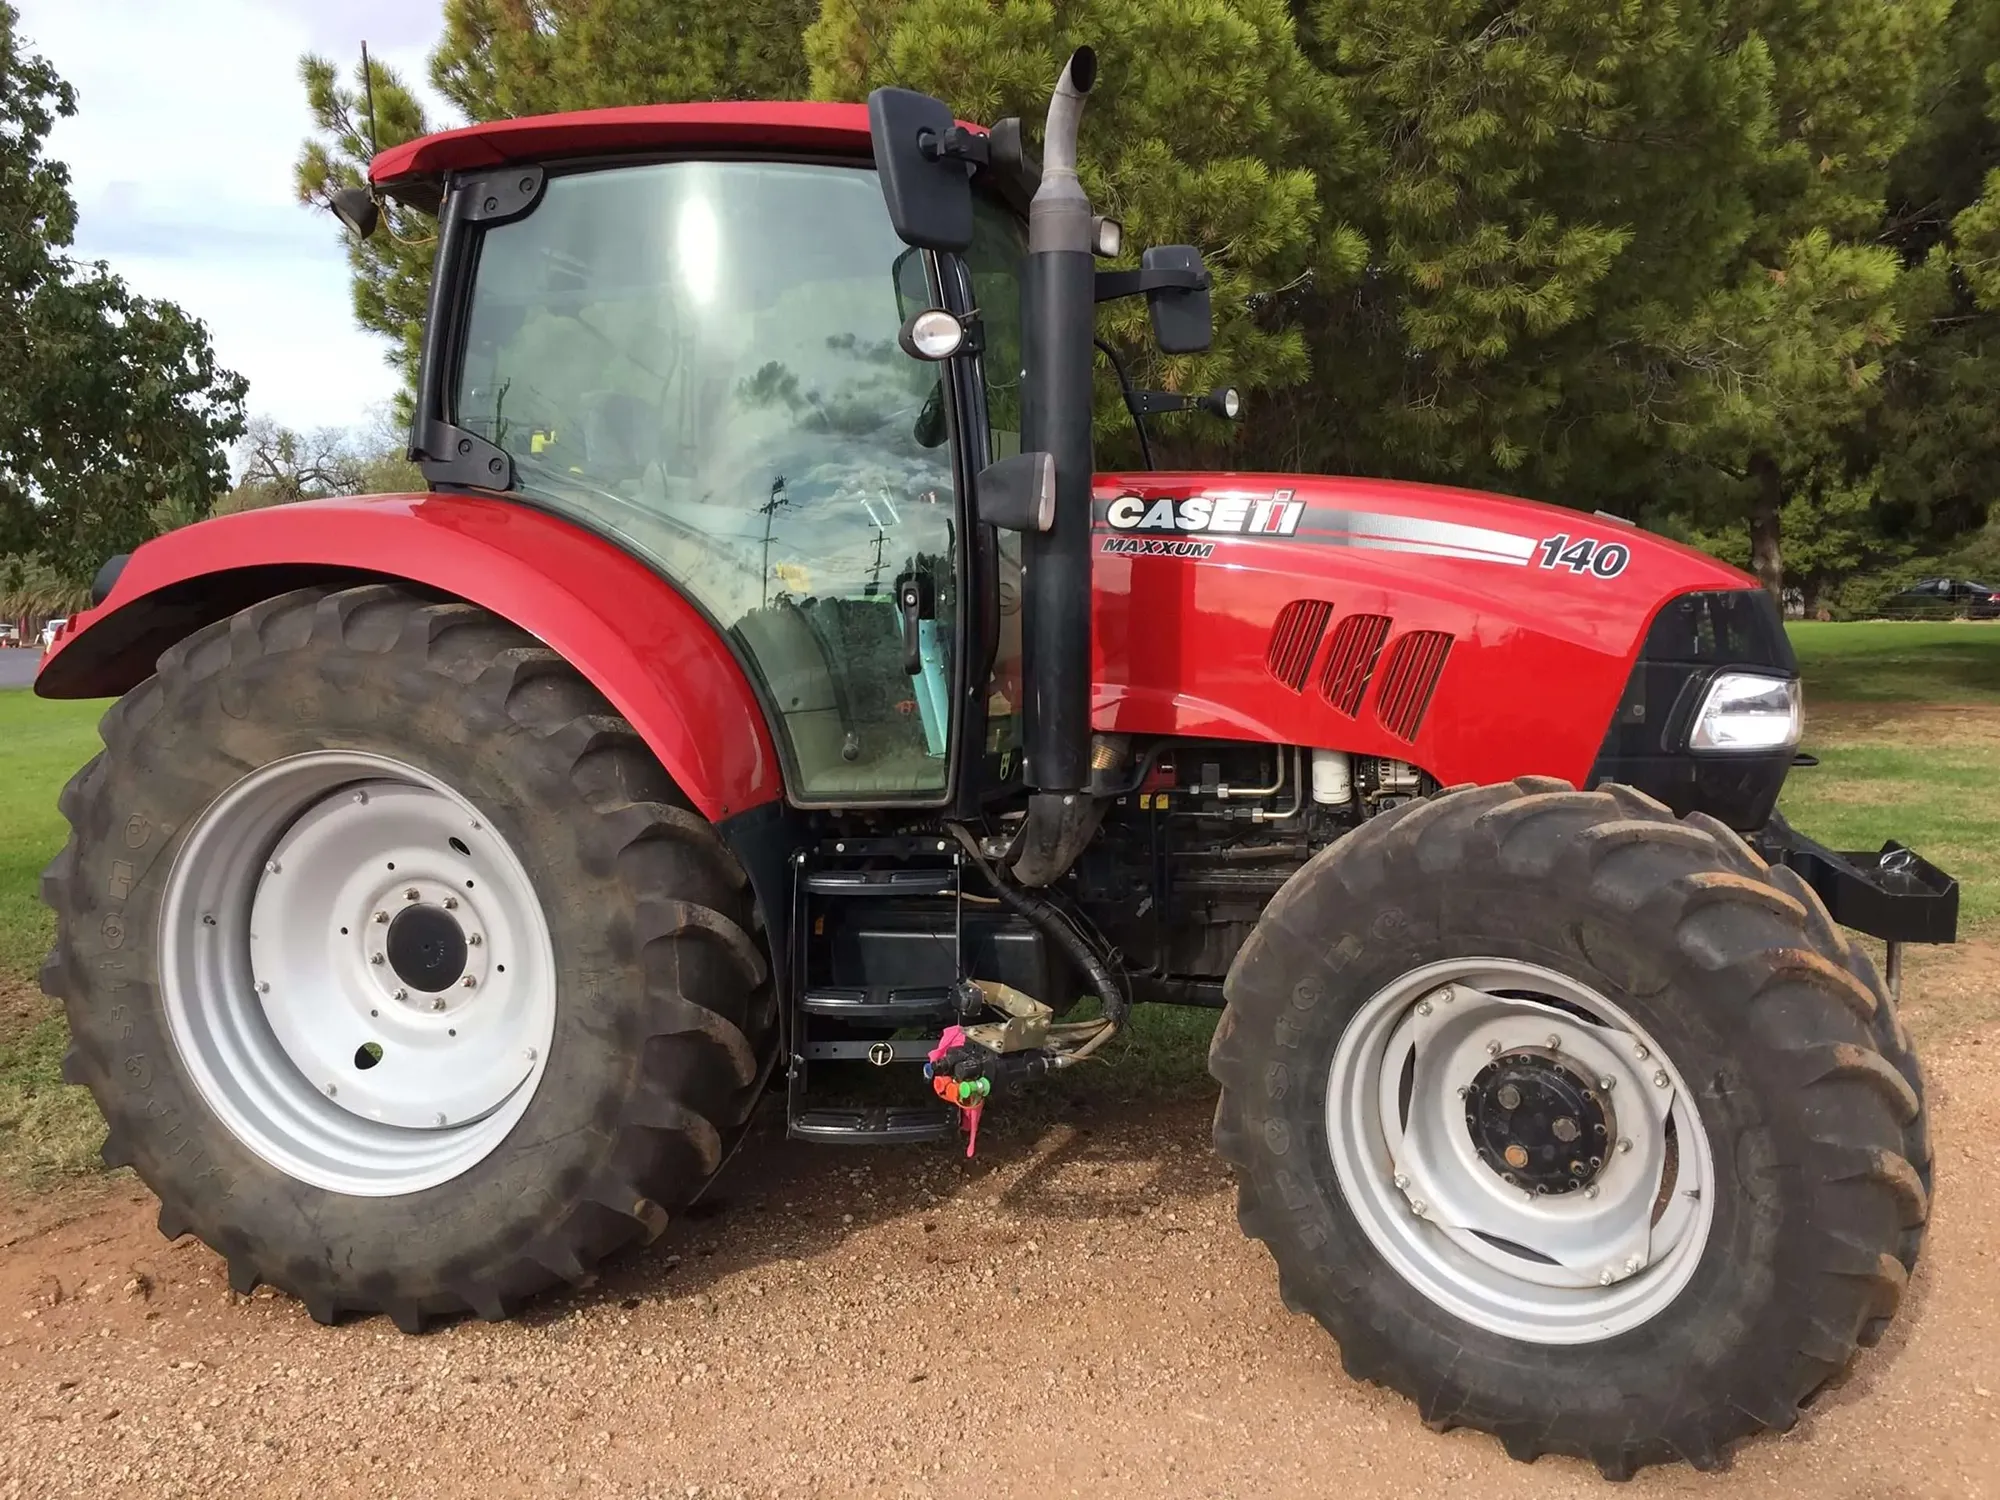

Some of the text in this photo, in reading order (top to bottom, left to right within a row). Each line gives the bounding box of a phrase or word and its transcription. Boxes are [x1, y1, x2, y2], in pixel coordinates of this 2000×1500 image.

[1107, 496, 1250, 531] CASE
[1102, 538, 1214, 558] MAXXUM
[1539, 533, 1630, 579] 140
